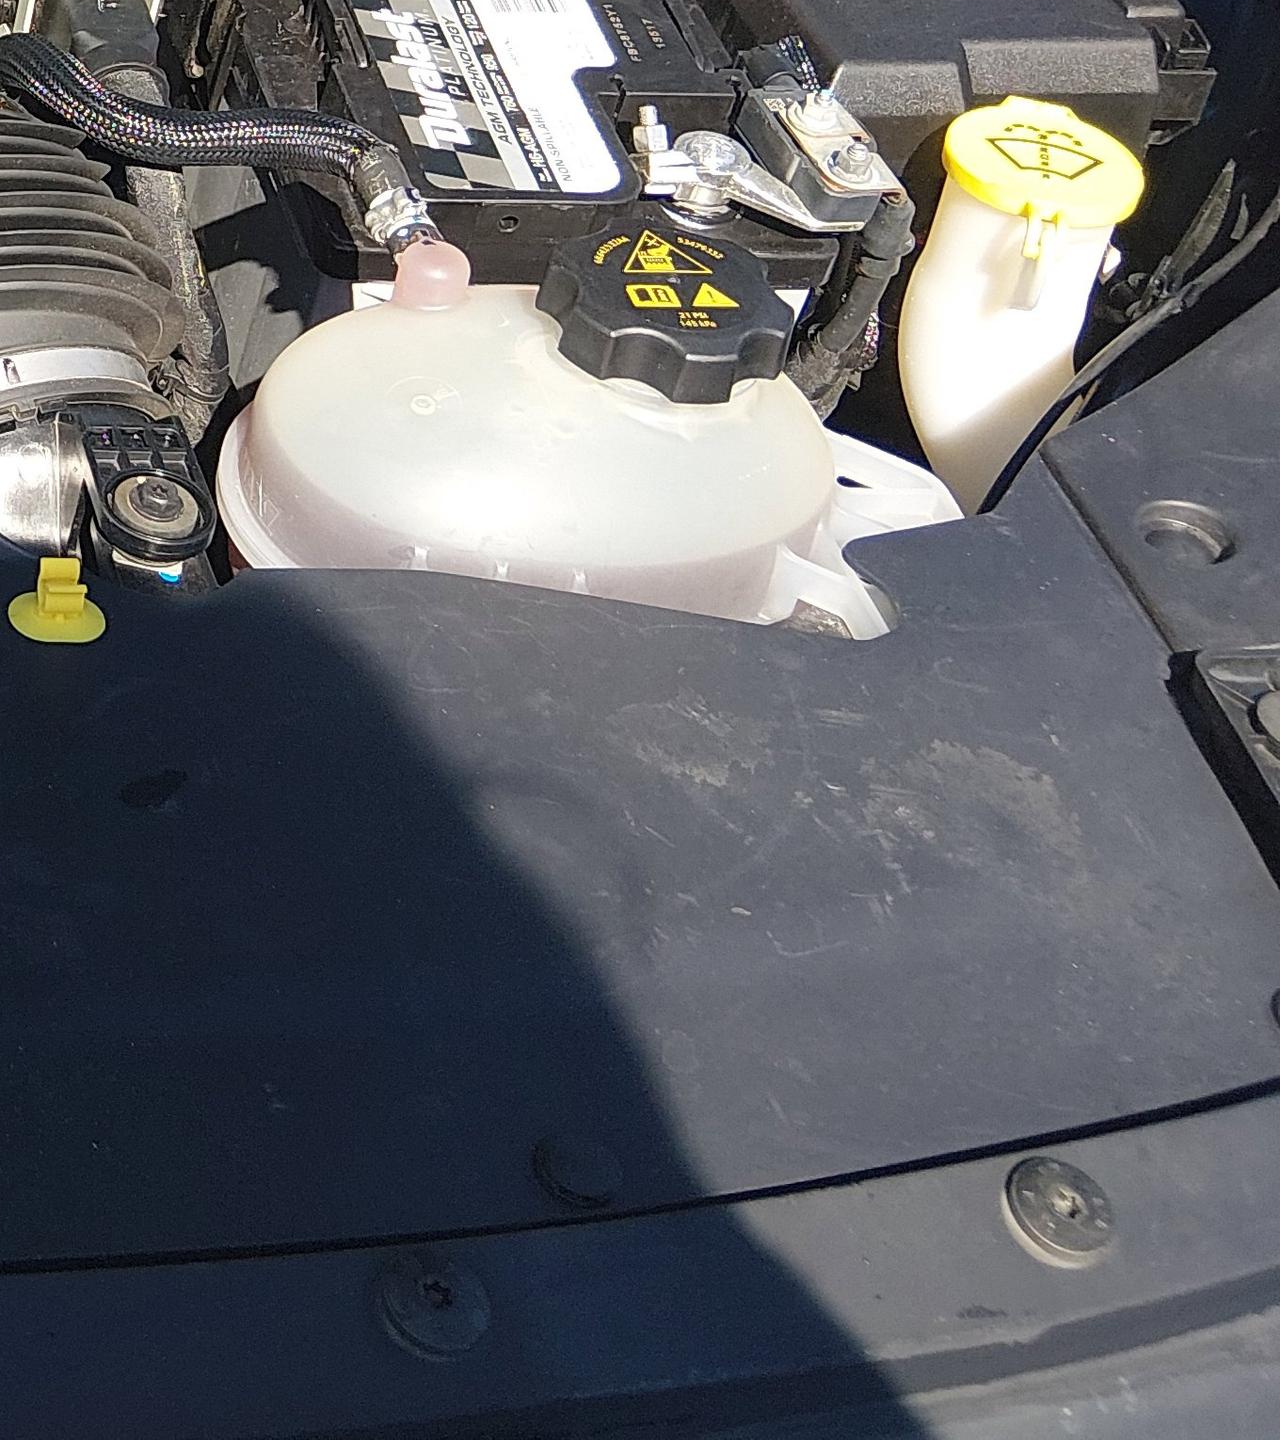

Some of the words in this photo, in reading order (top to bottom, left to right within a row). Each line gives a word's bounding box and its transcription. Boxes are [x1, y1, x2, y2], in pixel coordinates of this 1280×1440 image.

[372, 6, 472, 152] Duralast
[413, 11, 470, 98] PLATINUM
[441, 15, 495, 107] TECHNOLOGY
[486, 110, 513, 146] AGM
